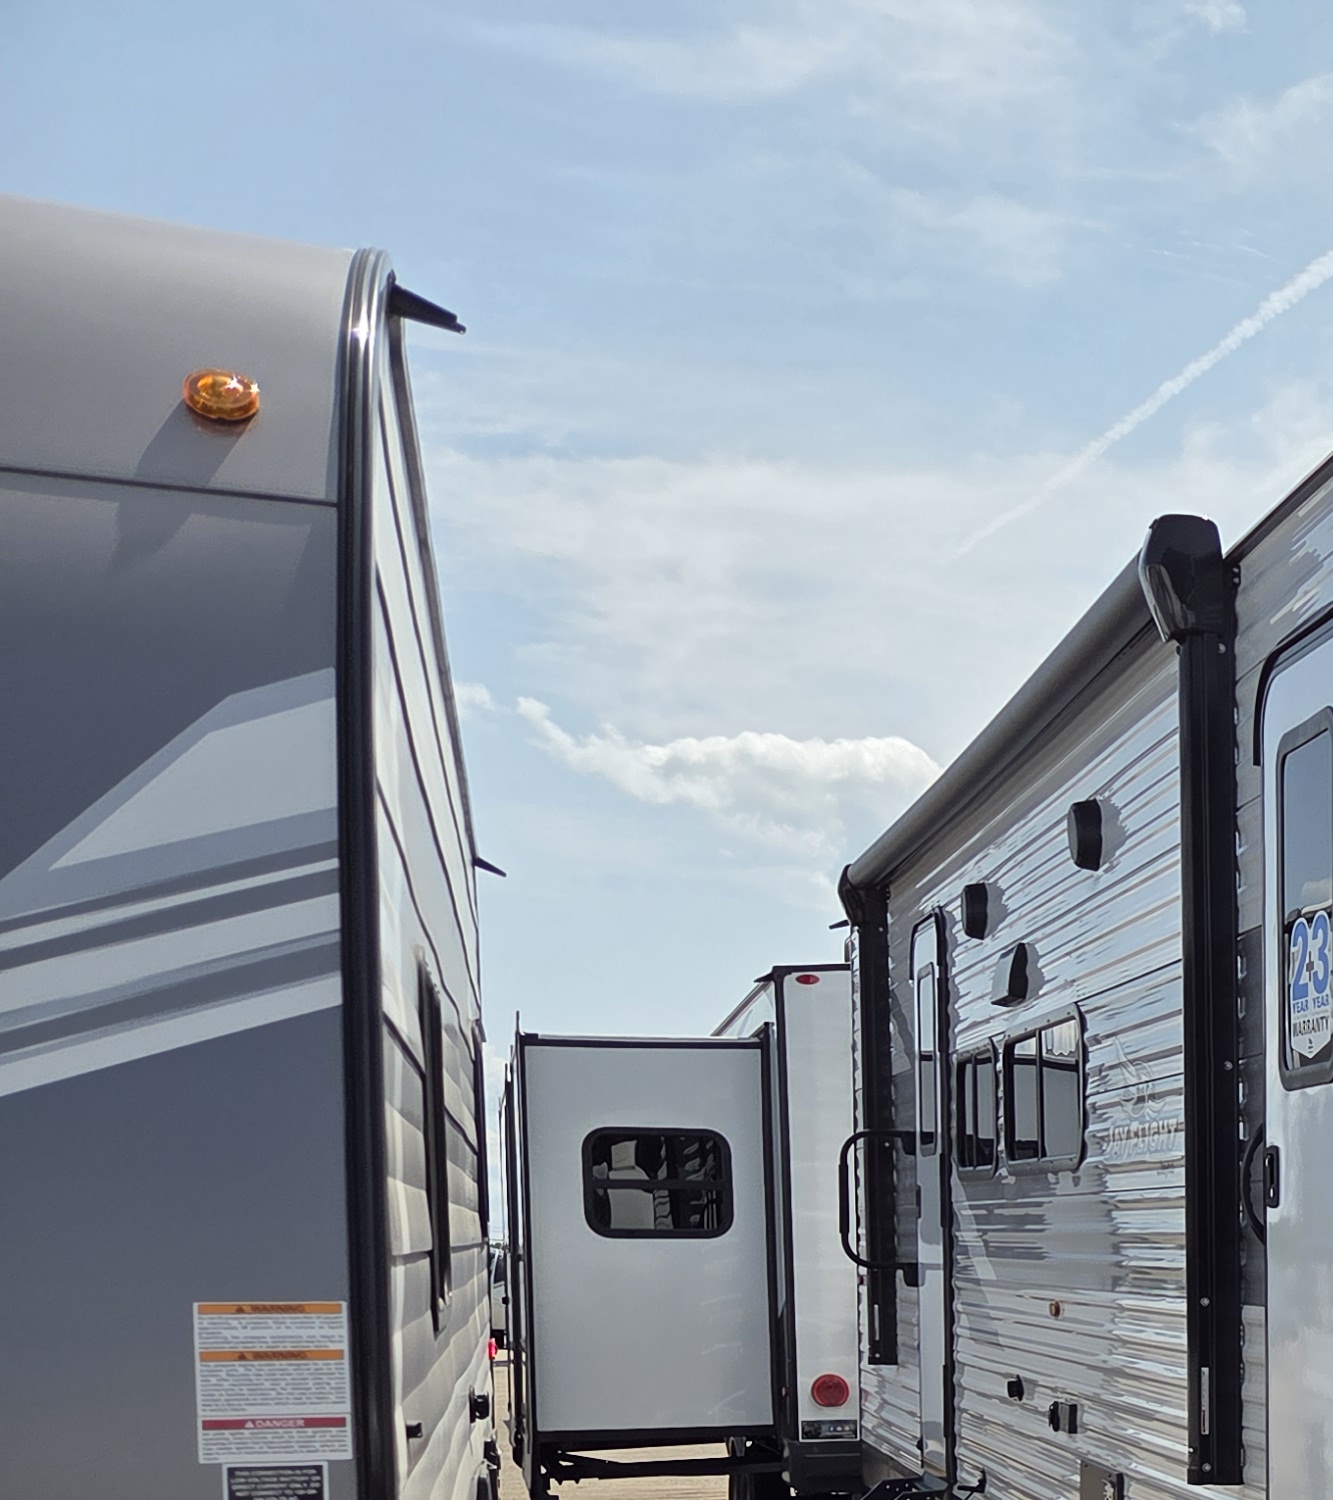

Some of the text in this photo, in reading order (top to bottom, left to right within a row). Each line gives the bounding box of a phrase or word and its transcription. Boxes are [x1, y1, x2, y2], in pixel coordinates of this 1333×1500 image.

[1292, 999, 1309, 1014] YEAR
[1312, 993, 1329, 1009] YEAR
[1292, 1015, 1329, 1038] WARRANTY
[1103, 1117, 1179, 1158] JAY FLIGHT
[255, 1419, 305, 1429] DANGER
